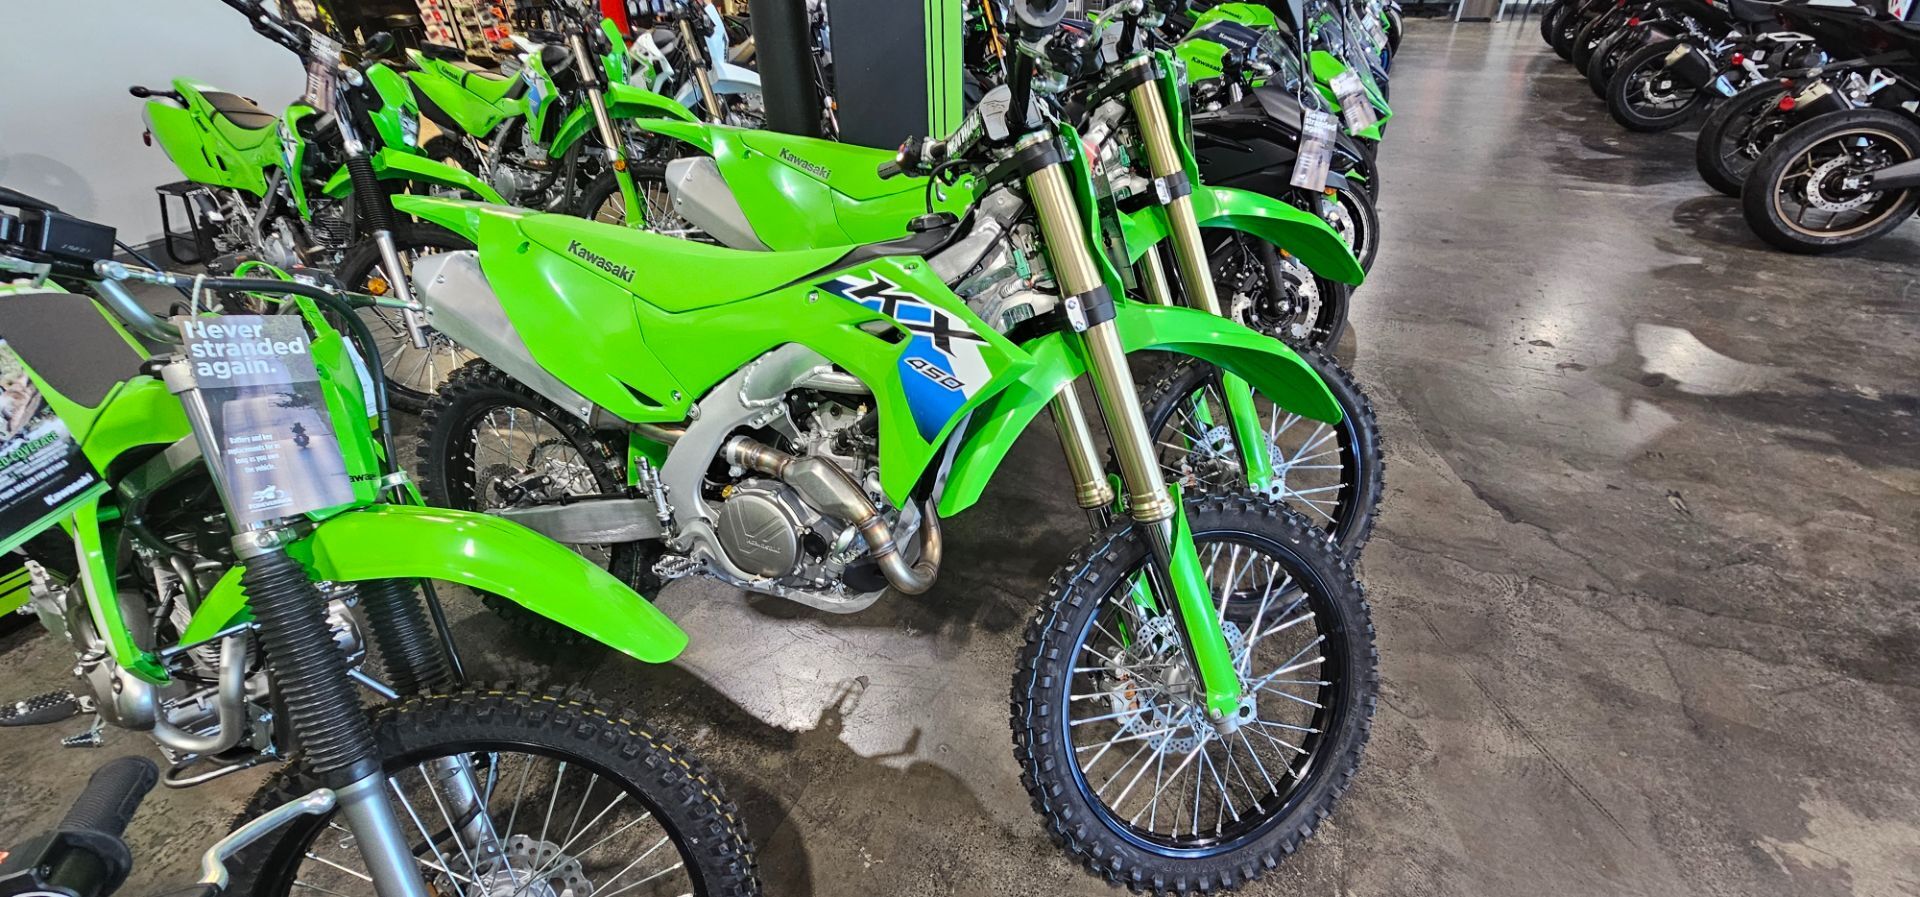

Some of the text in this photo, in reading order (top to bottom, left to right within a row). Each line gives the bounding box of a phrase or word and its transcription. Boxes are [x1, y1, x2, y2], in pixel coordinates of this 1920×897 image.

[779, 147, 832, 179] Kawasaki
[567, 240, 636, 283] Kawasaki
[184, 320, 263, 339] Never
[847, 272, 988, 358] KX
[191, 337, 306, 358] stranded
[196, 358, 277, 379] again.
[904, 357, 965, 391] 450
[43, 472, 94, 506] Kawasaki
